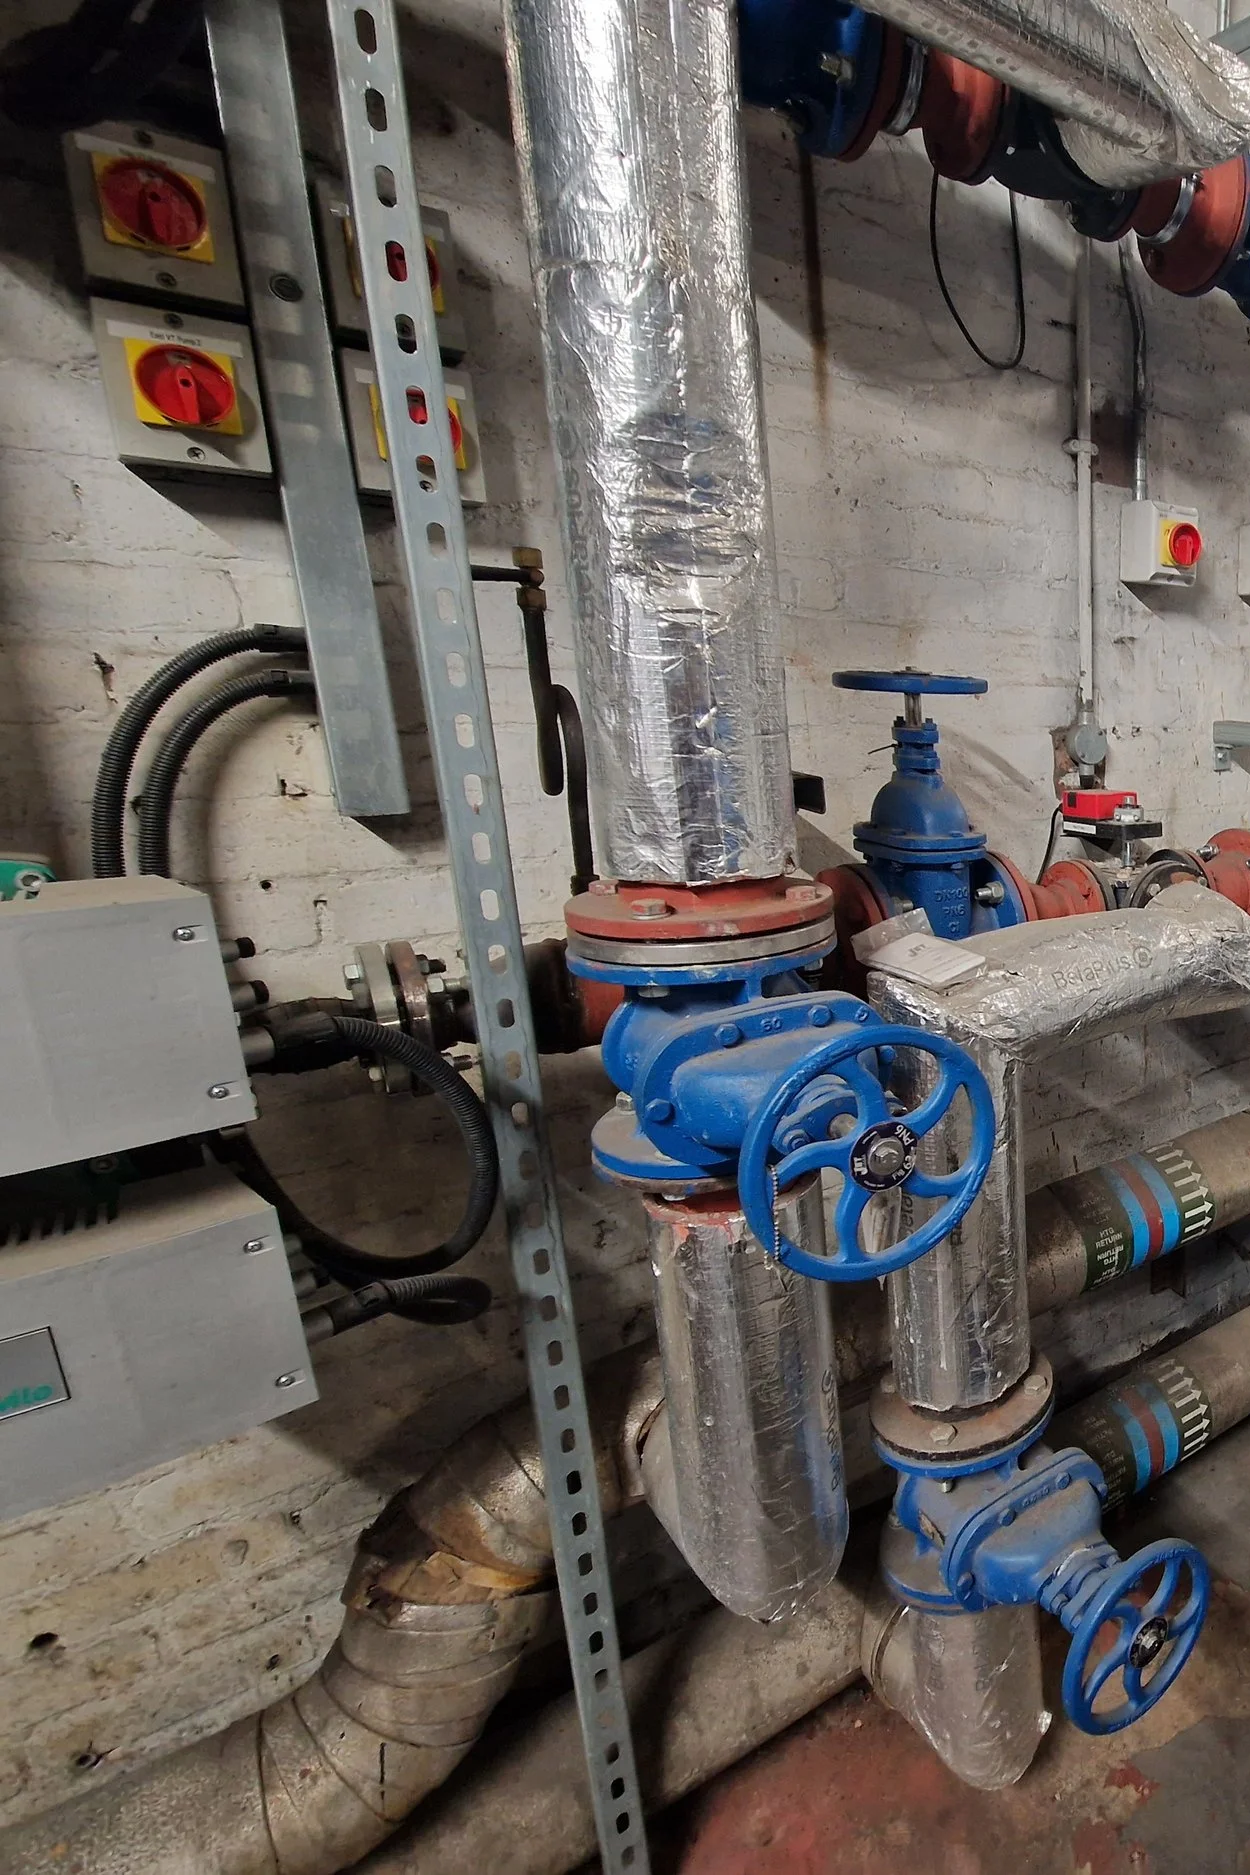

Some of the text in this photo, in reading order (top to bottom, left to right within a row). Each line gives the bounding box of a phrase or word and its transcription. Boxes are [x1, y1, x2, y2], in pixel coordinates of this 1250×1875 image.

[895, 1125, 915, 1146] PN6
[1095, 1232, 1123, 1249] RETURN
[1097, 1244, 1124, 1261] RETURN
